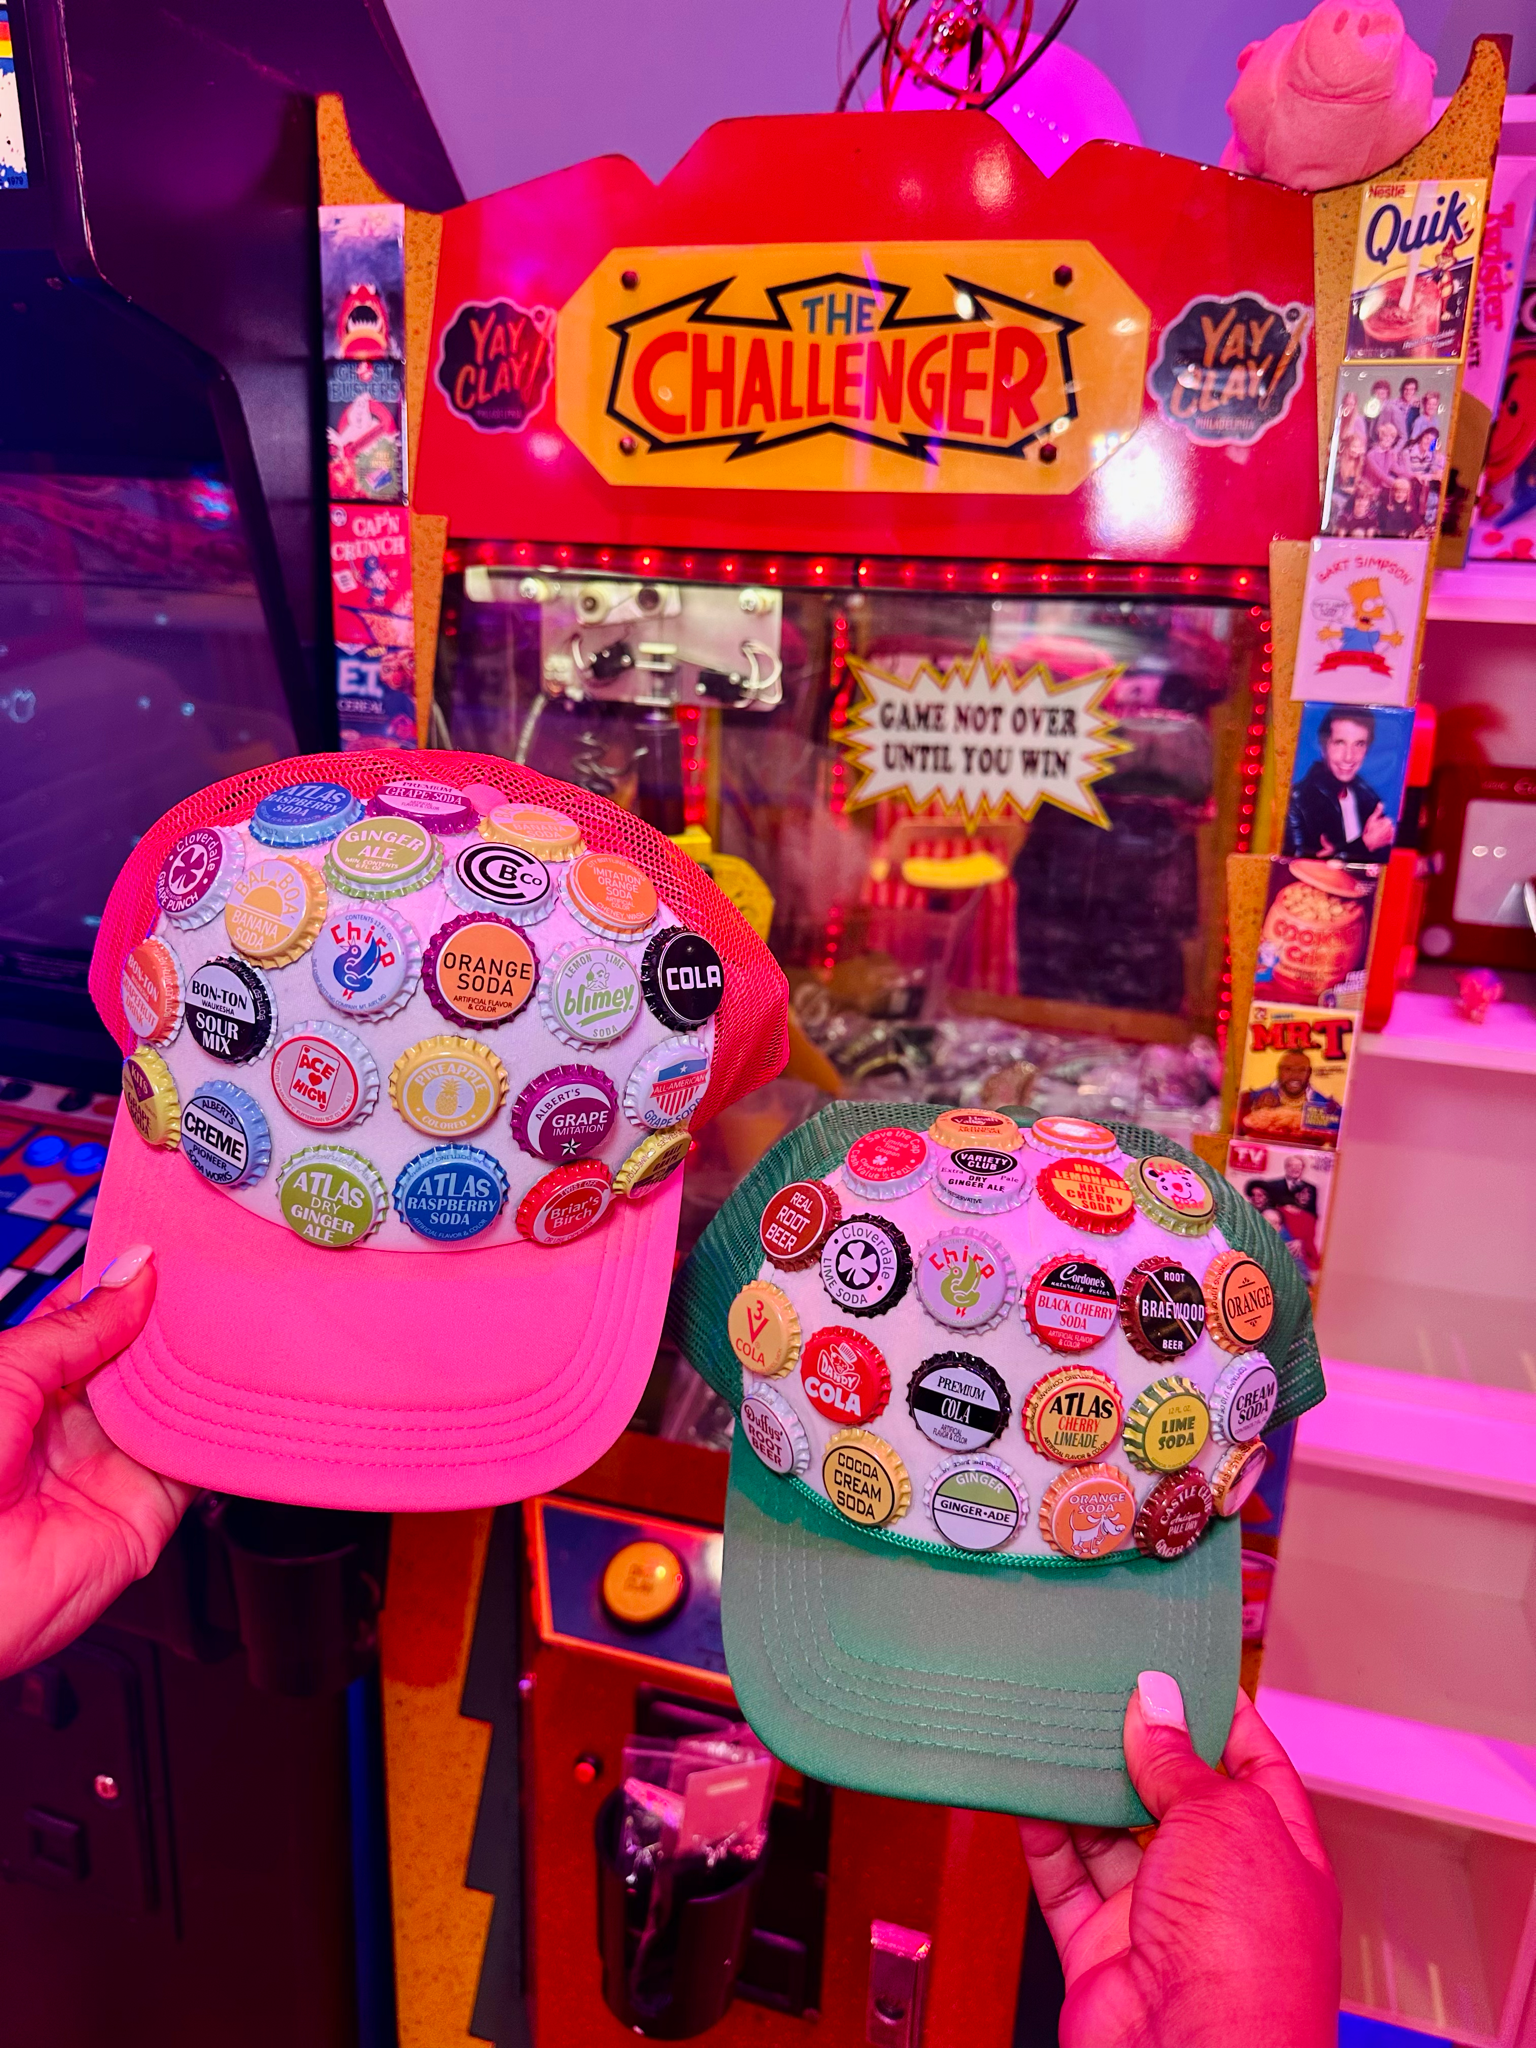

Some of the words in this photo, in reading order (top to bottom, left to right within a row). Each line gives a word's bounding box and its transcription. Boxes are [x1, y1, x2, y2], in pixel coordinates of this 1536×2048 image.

[1366, 191, 1467, 264] Quik
[801, 293, 875, 335] THE
[469, 311, 526, 365] YAY
[1201, 307, 1275, 368] YAY
[632, 326, 1048, 439] CHALLENGER
[352, 511, 400, 537] CAP'N
[331, 535, 406, 561] CRUNCH
[1317, 559, 1350, 583] BART
[1355, 557, 1413, 585] SIMPSON
[881, 702, 945, 732] GAME
[955, 706, 1004, 733] NOT
[1013, 707, 1077, 736] OVER
[883, 743, 953, 772] UNTIL
[961, 747, 1012, 775] YOU
[1022, 750, 1070, 778] WIN
[281, 785, 346, 804] ATLAS
[385, 787, 432, 800] GRAPE
[434, 792, 462, 805] SODA
[402, 782, 452, 793] PREMIUM
[265, 794, 341, 813] RASPBERRY
[273, 804, 310, 816] SODA
[512, 823, 566, 832] BANANA
[526, 830, 562, 838] SODA
[345, 830, 424, 851] GINGER
[176, 833, 220, 871] Cloverdale
[358, 845, 396, 860] ALE
[593, 867, 641, 886] IMITATION
[598, 876, 639, 894] ORANGE
[166, 892, 199, 912] PUNCH
[606, 886, 633, 900] SODA
[231, 909, 278, 939] BANANA
[233, 927, 264, 949] SODA
[444, 952, 532, 980] ORANGE
[565, 953, 593, 979] LEMON
[605, 953, 626, 970] LIME
[128, 954, 159, 1002] BON-TON
[457, 973, 513, 996] SODA
[666, 965, 722, 991] COLA
[123, 976, 155, 1026] GRAPEFRUIT
[192, 980, 247, 1010] BON-TON
[453, 995, 487, 1005] ARTIFICIAL
[488, 1000, 512, 1008] FLAVOR
[126, 995, 143, 1026] DRINK
[201, 1000, 235, 1016] WAUKESHA
[475, 1004, 496, 1013] COLOR
[196, 1011, 239, 1040] SOUR
[593, 1025, 618, 1038] SODA
[202, 1033, 231, 1055] MIX
[1313, 1020, 1352, 1059] T
[299, 1054, 335, 1080] ACE
[131, 1065, 149, 1095] KITS
[415, 1064, 488, 1093] PINEAPPLE
[654, 1074, 706, 1094] ALL-AMERICAN
[293, 1079, 327, 1104] HIGH
[201, 1100, 236, 1125] ALBERT'S
[535, 1088, 580, 1121] ALBERT'S
[422, 1115, 467, 1130] COLORED
[552, 1110, 609, 1128] GRAPE
[553, 1124, 604, 1136] IMITATION
[644, 1110, 672, 1129] GRAPE
[184, 1111, 244, 1162] CREME
[865, 1130, 893, 1143] Save
[896, 1130, 912, 1140] the
[882, 1137, 909, 1148] Limited
[192, 1144, 227, 1171] PIONEER
[875, 1145, 900, 1158] Coupon
[961, 1152, 1009, 1165] VARIETY
[1236, 1148, 1265, 1164] TV
[187, 1149, 204, 1173] SODA
[205, 1166, 232, 1182] WORKS
[857, 1165, 880, 1179] Value
[891, 1165, 913, 1178] cent
[860, 1158, 894, 1172] Cloverdale
[967, 1161, 997, 1171] CLUB
[1074, 1163, 1101, 1175] HALF
[293, 1172, 365, 1208] ATLAS
[417, 1173, 491, 1198] ATLAS
[559, 1181, 582, 1197] TWIST
[948, 1179, 984, 1189] GINGER
[988, 1184, 1005, 1192] ALE
[1054, 1170, 1126, 1190] LEMONADE
[1079, 1183, 1106, 1194] HALF
[311, 1196, 341, 1214] DRY
[407, 1197, 497, 1212] RASPBERRY
[550, 1196, 600, 1220] Briar's
[790, 1192, 813, 1214] REAL
[949, 1190, 982, 1204] PRESERVATIVE
[1066, 1189, 1123, 1206] CHERRY
[1082, 1200, 1114, 1213] SODA
[291, 1204, 355, 1234] GINGER
[413, 1217, 437, 1237] ARTIFICIAL
[469, 1219, 487, 1232] COLOR
[430, 1212, 470, 1225] SODA
[553, 1208, 592, 1229] Birch
[776, 1205, 811, 1233] ROOT
[303, 1224, 335, 1244] ALE
[765, 1223, 797, 1252] BEER
[842, 1225, 894, 1280] Cloverdale
[823, 1257, 838, 1289] LIME
[835, 1287, 868, 1304] SODA
[1060, 1264, 1106, 1288] Cordone's
[1164, 1272, 1185, 1283] ROOT
[1051, 1281, 1084, 1292] naturally
[1089, 1287, 1110, 1296] better
[1038, 1295, 1072, 1312] BLACK
[1074, 1302, 1115, 1320] CHERRY
[1142, 1299, 1205, 1322] BRAEWOOD
[1226, 1285, 1272, 1320] ORANGE
[1060, 1314, 1087, 1330] SODA
[1048, 1330, 1073, 1340] ARTIFICIAL
[1162, 1339, 1183, 1350] BEER
[736, 1338, 765, 1367] COLA
[820, 1353, 858, 1389] DANDY
[804, 1376, 861, 1417] COLA
[937, 1376, 986, 1401] PREMIUM
[1236, 1381, 1275, 1411] CREAM
[941, 1398, 971, 1424] COLA
[1049, 1392, 1114, 1419] ATLAS
[1237, 1402, 1269, 1425] SODA
[933, 1428, 949, 1438] FLAVOR
[941, 1424, 962, 1435] ARTIFICIAL
[1058, 1416, 1101, 1433] CHERRY
[1161, 1416, 1196, 1434] LIME
[748, 1423, 782, 1456] ROOT
[1054, 1431, 1099, 1448] LIMEADE
[1158, 1432, 1195, 1450] SODA
[752, 1436, 782, 1467] BEER
[838, 1452, 879, 1481] COCOA
[834, 1469, 882, 1502] CREAM
[956, 1472, 1004, 1494] GINGER
[836, 1490, 875, 1520] SODA
[1069, 1492, 1126, 1504] ORANGE
[1078, 1504, 1114, 1514] SODA
[1160, 1485, 1197, 1525] CASTLE
[1170, 1512, 1200, 1525] Antique
[1155, 1538, 1185, 1558] GINGER
